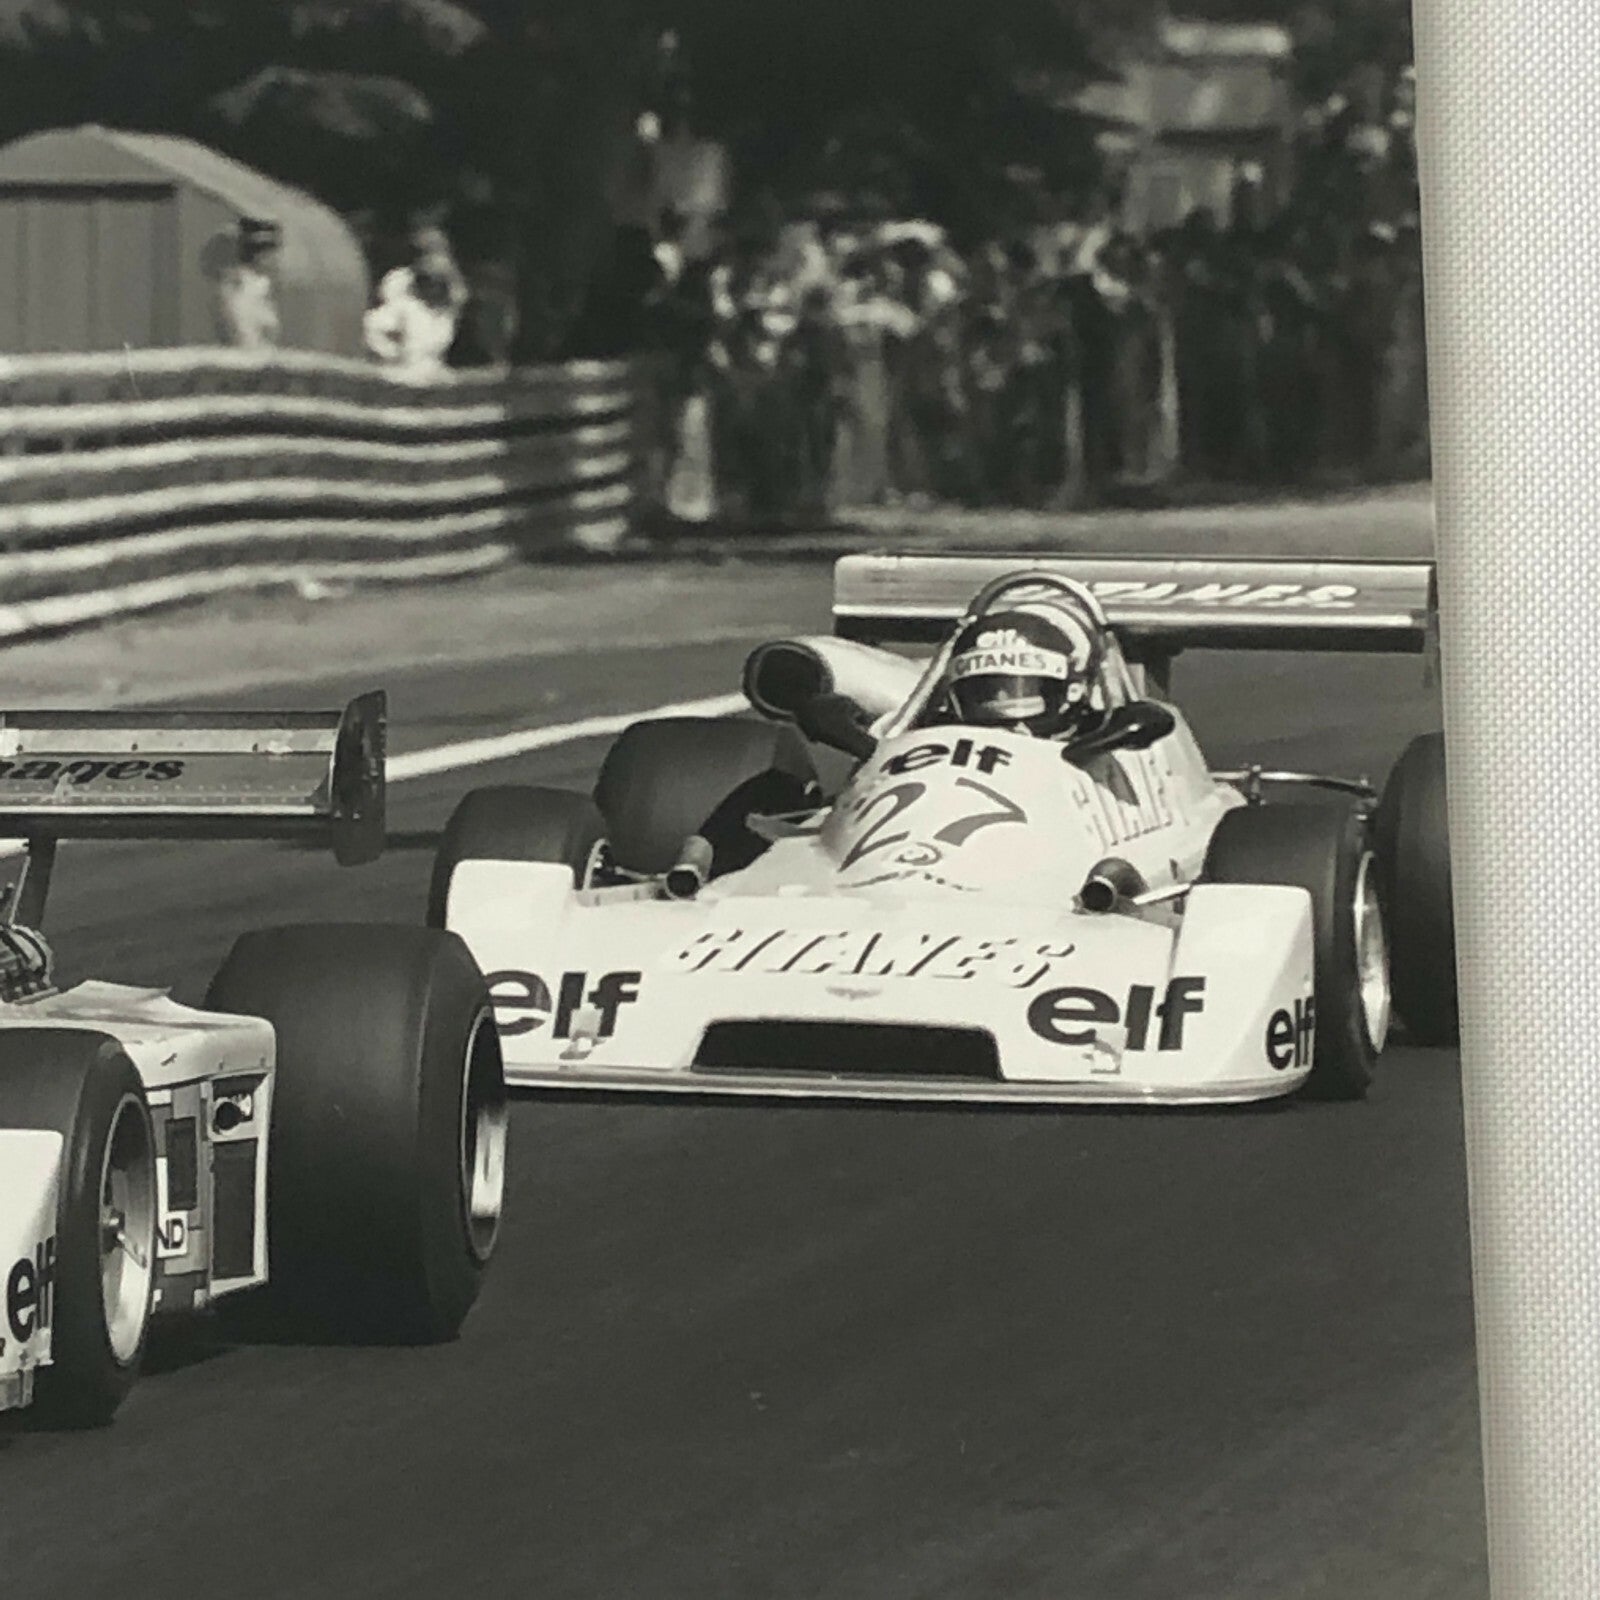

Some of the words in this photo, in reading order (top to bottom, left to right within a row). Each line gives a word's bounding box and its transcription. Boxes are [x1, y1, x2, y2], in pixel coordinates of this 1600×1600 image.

[954, 652, 1047, 675] GITANES
[880, 738, 1013, 776] elf
[838, 777, 1028, 873] 27
[672, 927, 1077, 989] GITANES
[484, 970, 642, 1039] elf
[1027, 976, 1207, 1051] elf
[1265, 996, 1314, 1071] elf
[7, 1236, 56, 1344] elf
